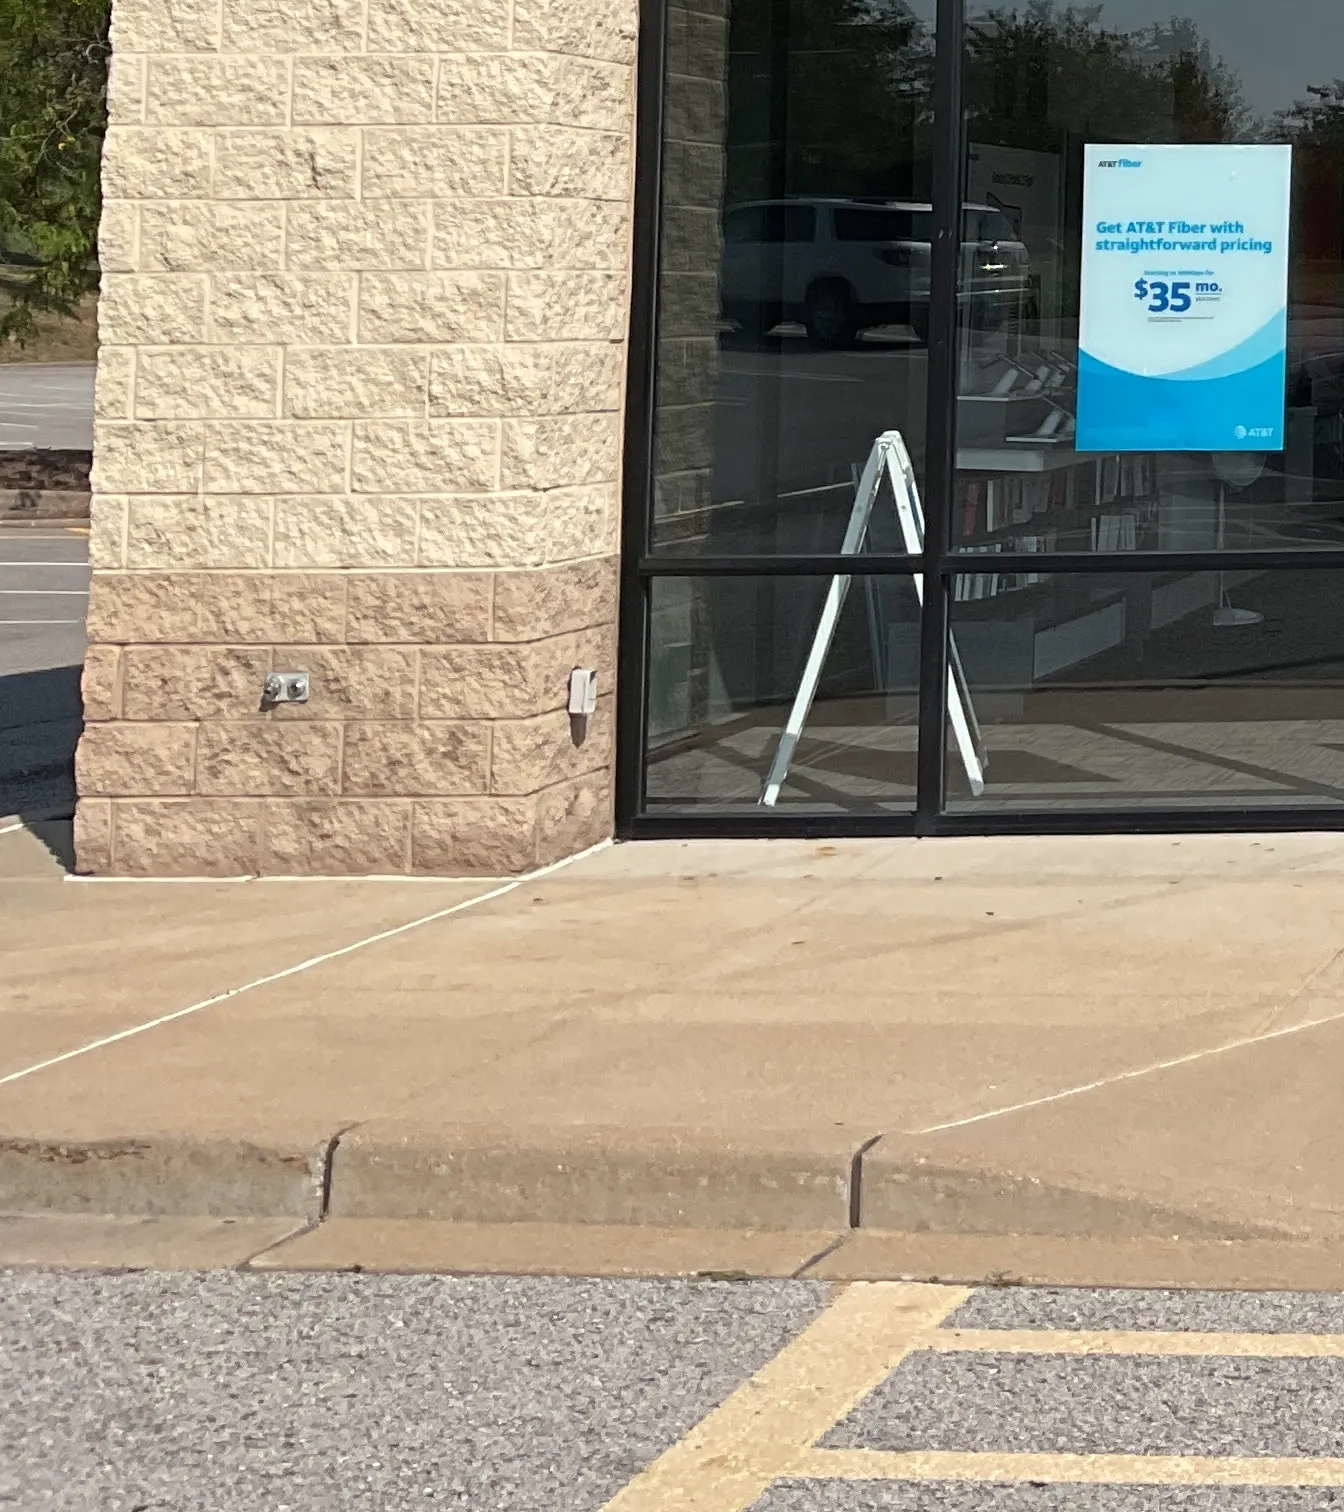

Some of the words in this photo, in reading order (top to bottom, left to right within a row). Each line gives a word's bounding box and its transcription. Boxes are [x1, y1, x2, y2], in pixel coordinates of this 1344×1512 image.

[1096, 221, 1122, 234] Get
[1126, 221, 1165, 234] AT&T
[1168, 221, 1206, 234] Fiber
[1210, 220, 1244, 234] with
[1095, 238, 1216, 254] straightforward
[1220, 238, 1273, 254] pricing
[1134, 277, 1192, 313] $35
[1195, 282, 1223, 293] mo.
[1248, 427, 1274, 437] AT&T
